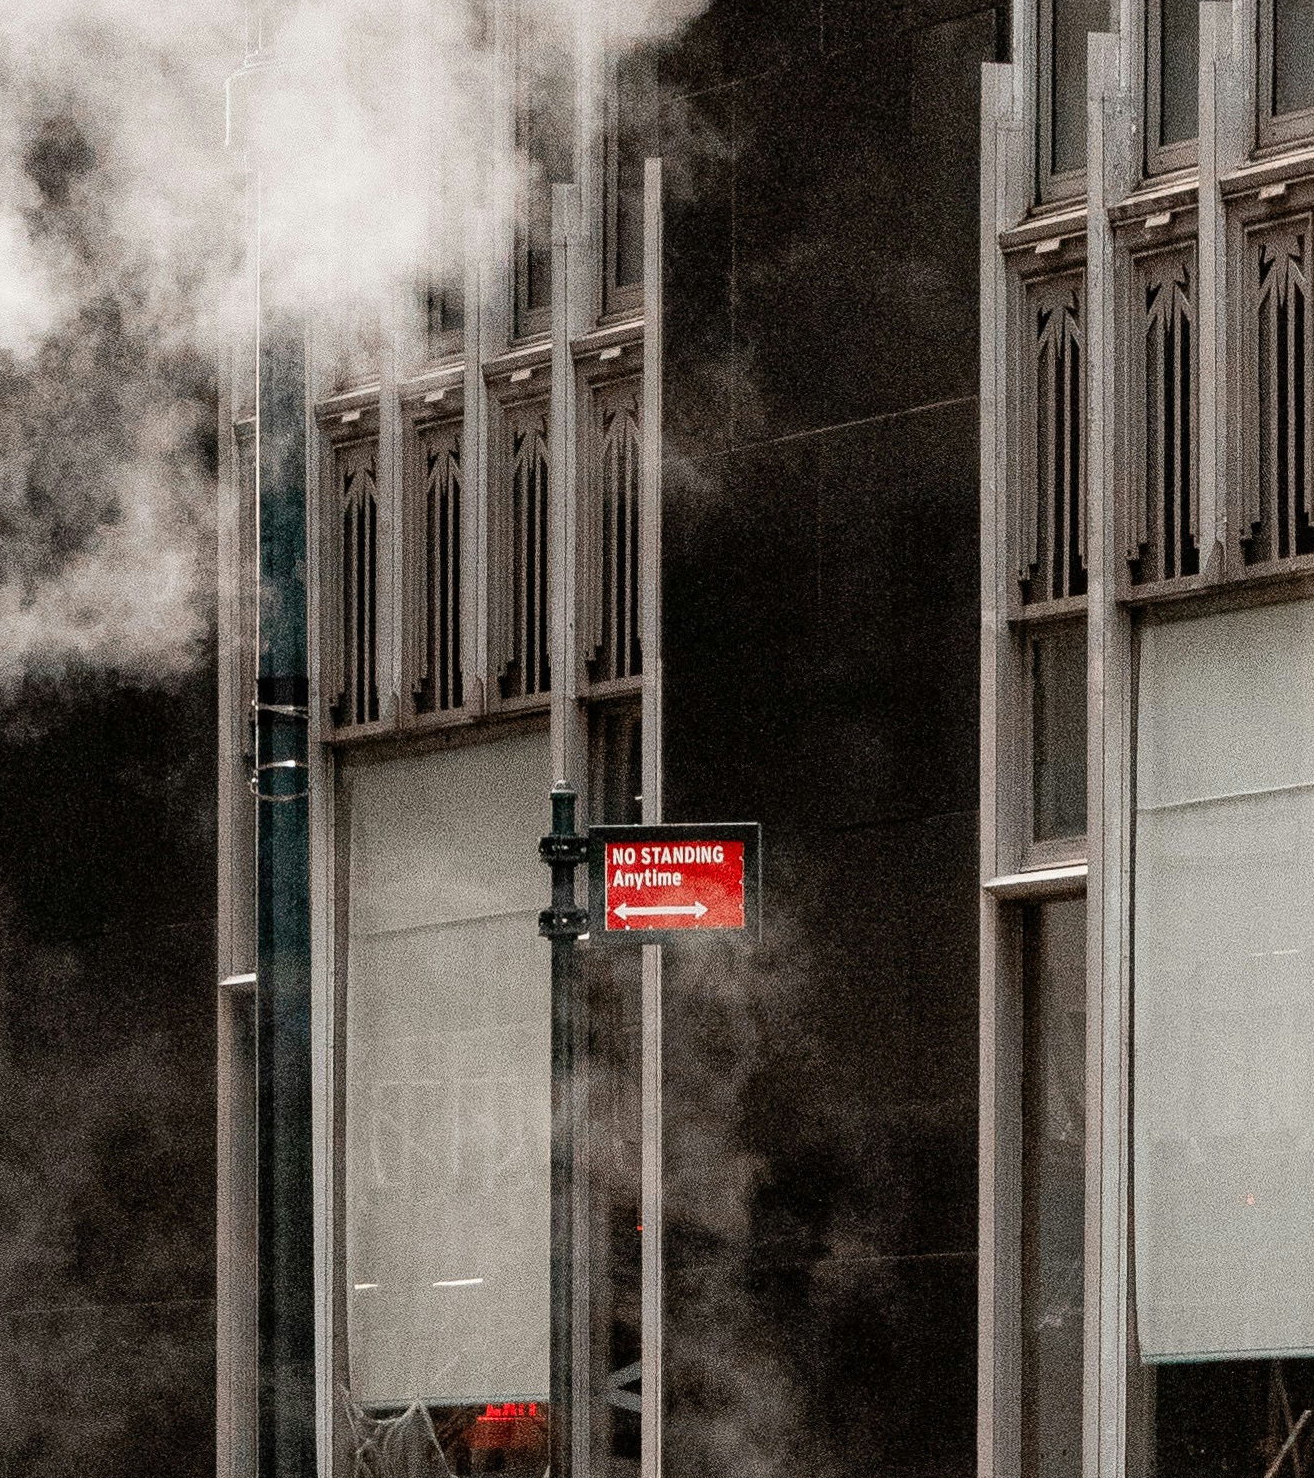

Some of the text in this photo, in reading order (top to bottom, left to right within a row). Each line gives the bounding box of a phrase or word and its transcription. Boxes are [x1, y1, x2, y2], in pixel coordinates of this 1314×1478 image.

[612, 845, 724, 865] NO STANDING
[612, 868, 682, 891] Anytime
